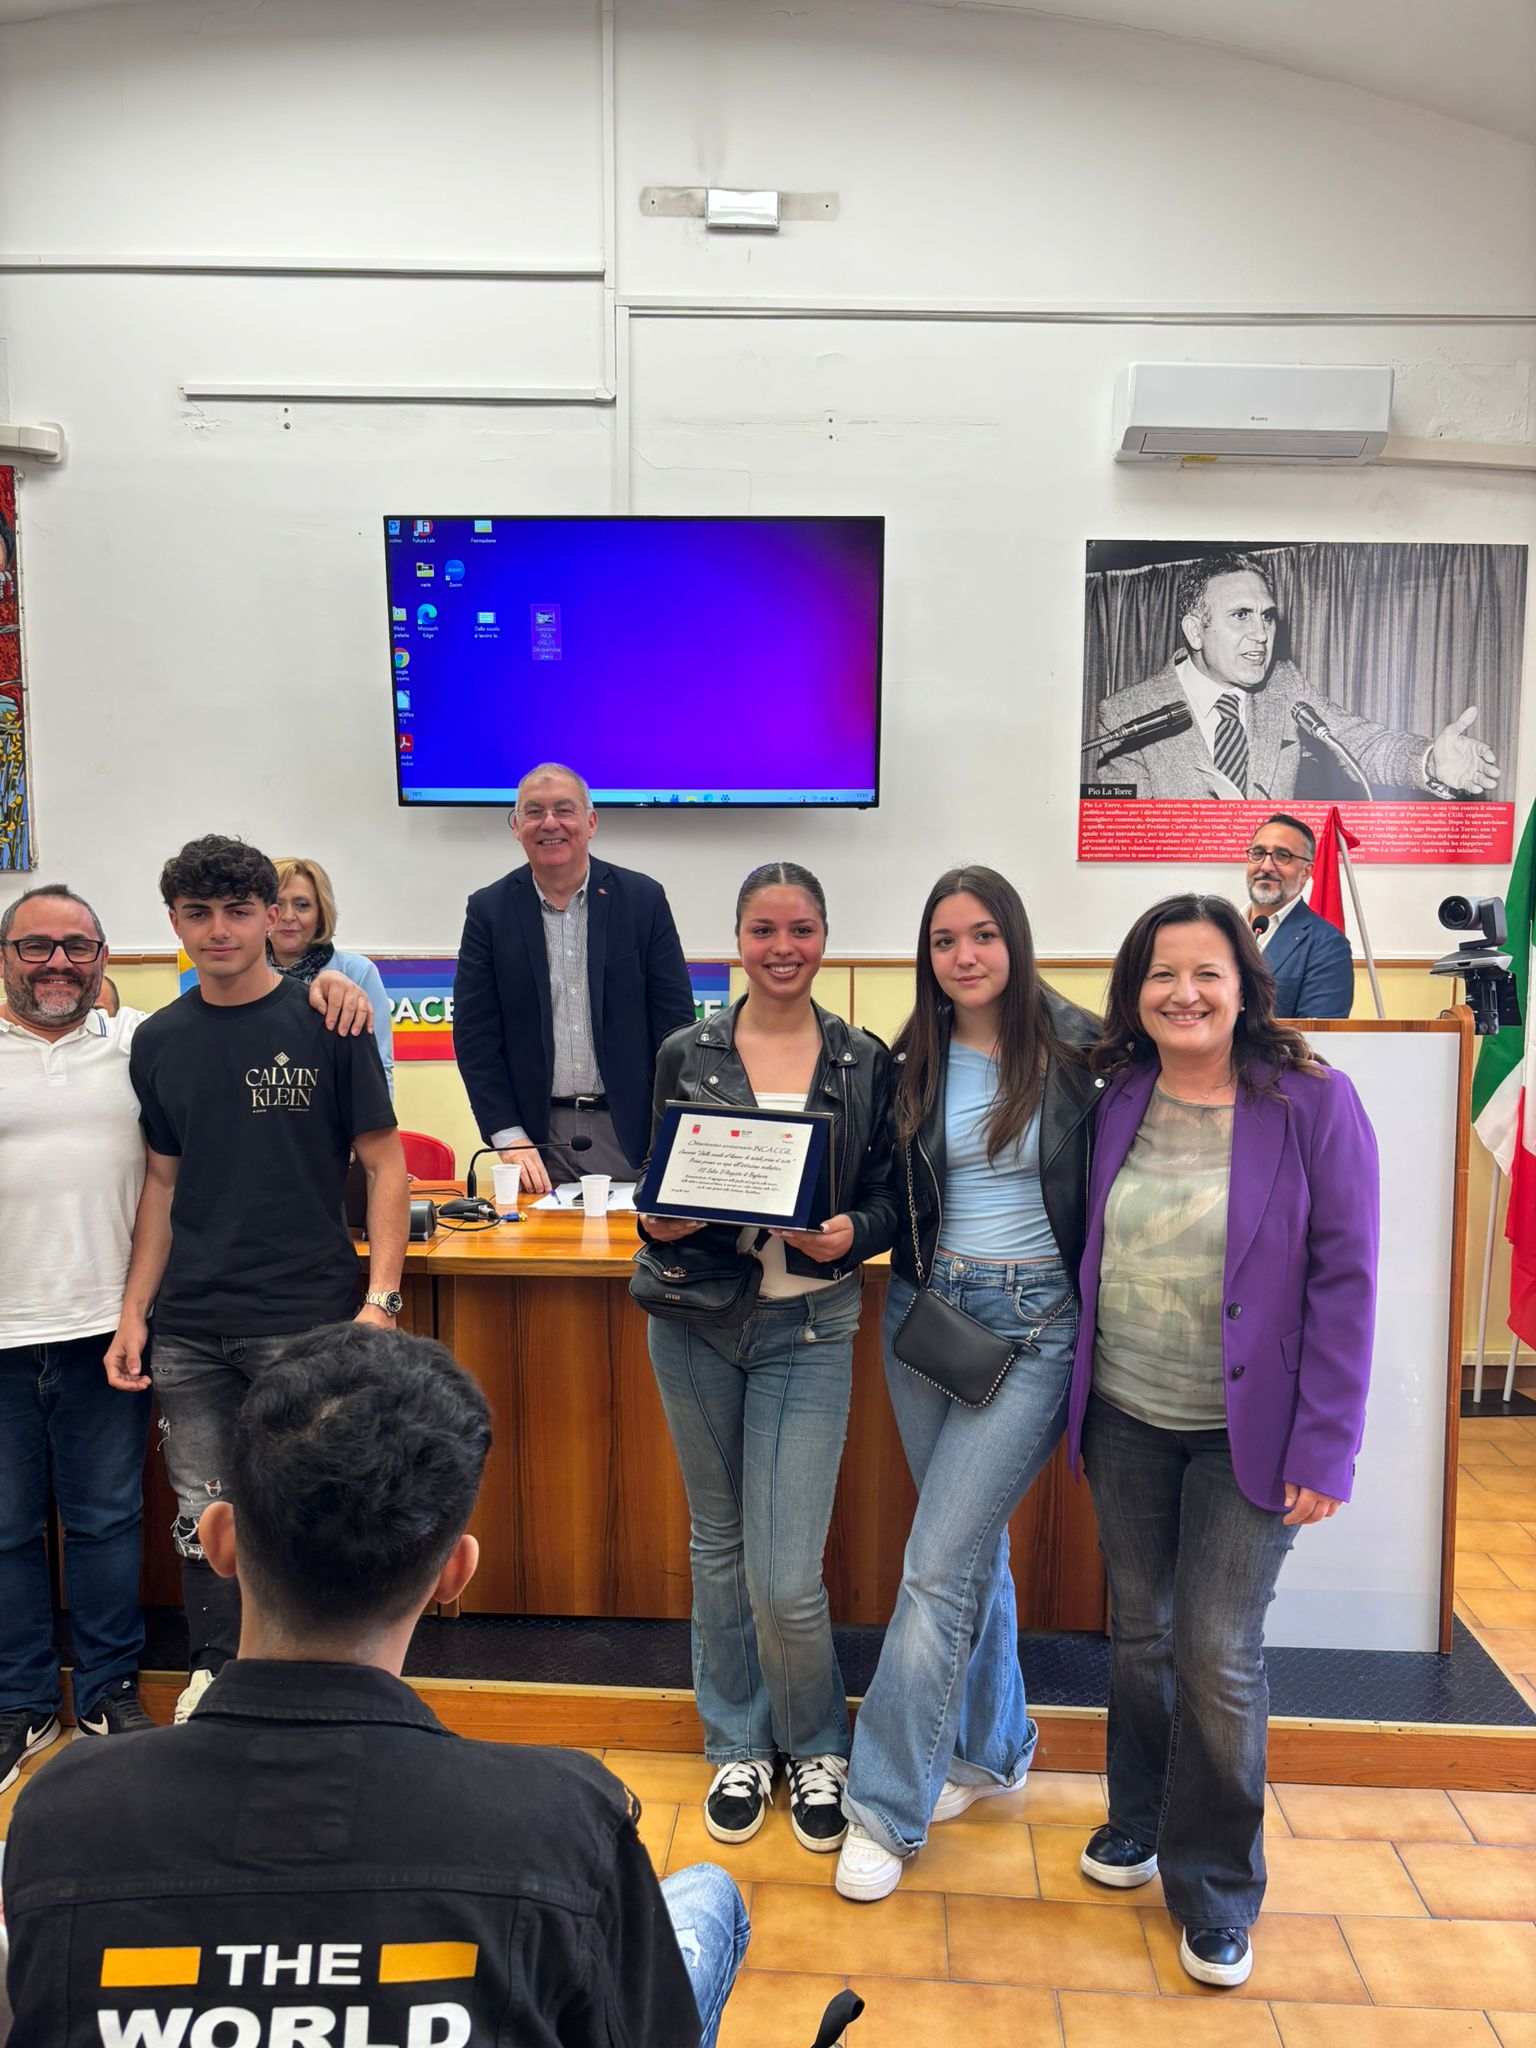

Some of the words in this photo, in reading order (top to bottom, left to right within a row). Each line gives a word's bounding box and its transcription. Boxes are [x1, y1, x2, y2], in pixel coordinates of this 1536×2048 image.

[245, 1067, 320, 1087] CALVIN
[252, 1087, 312, 1107] KLEIN
[216, 1943, 362, 1985] THE
[97, 2002, 471, 2048] WORLD
